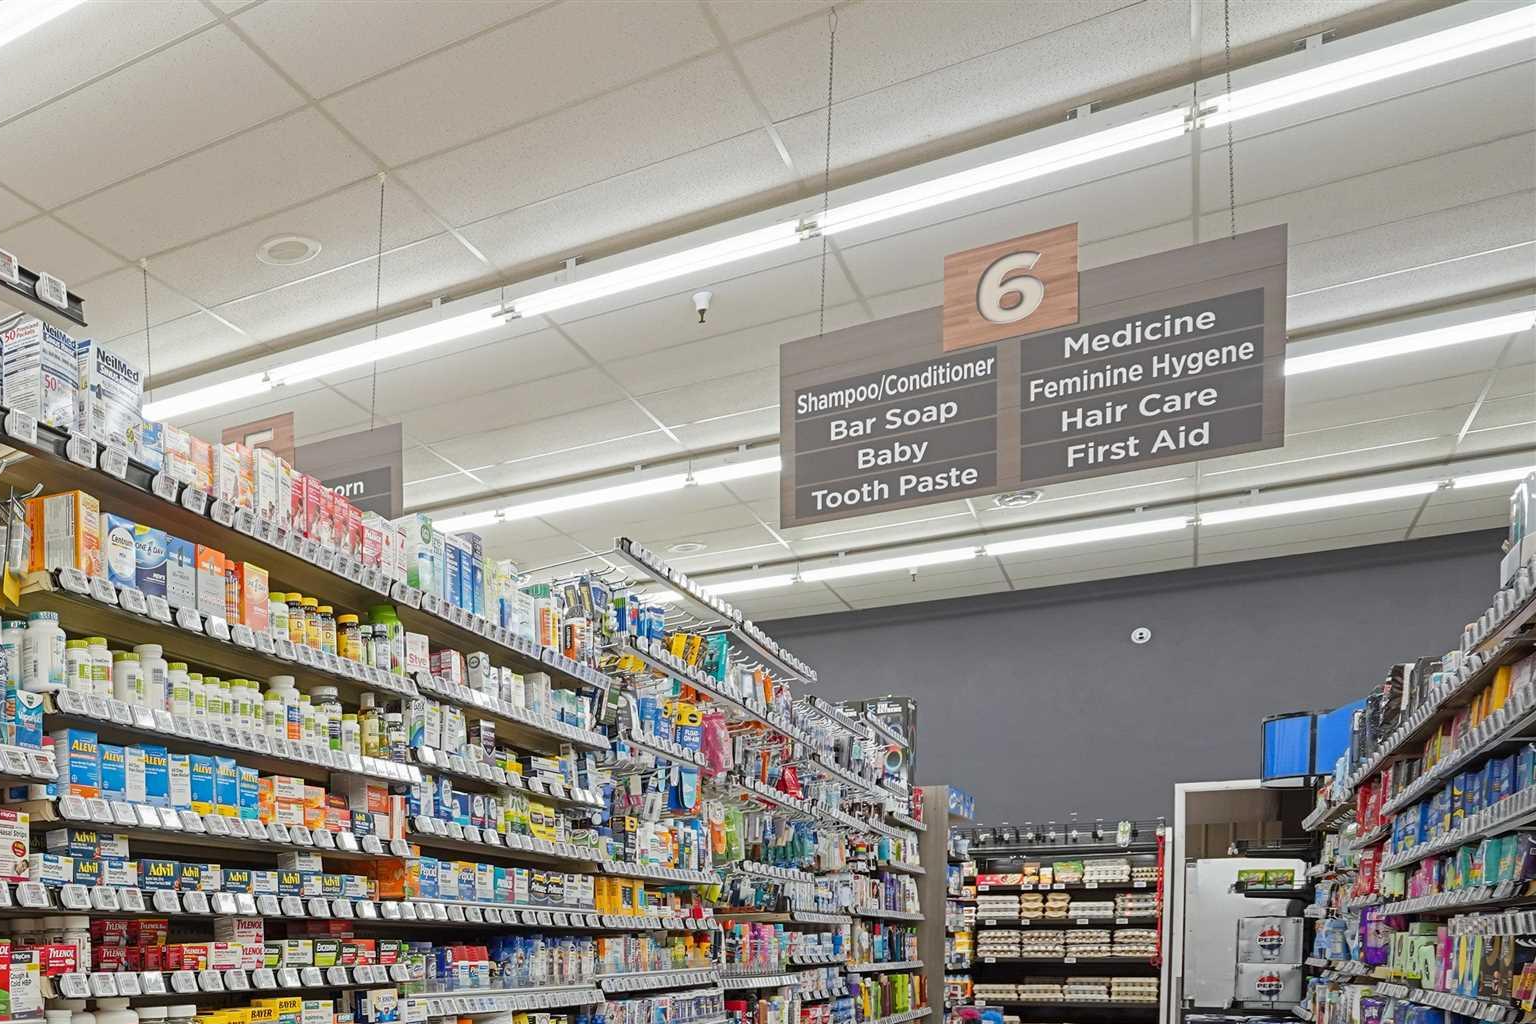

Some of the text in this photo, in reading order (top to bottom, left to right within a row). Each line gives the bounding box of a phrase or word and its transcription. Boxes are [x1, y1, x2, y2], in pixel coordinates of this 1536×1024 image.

[976, 249, 1046, 325] 6
[43, 321, 77, 349] NeilMed
[1063, 310, 1217, 359] Medicine
[97, 347, 139, 383] NeilMed
[797, 355, 995, 415] Shampoo/Conditioner
[1029, 340, 1255, 402] Feminine Hygene
[829, 400, 958, 441] Bar Soap
[1061, 386, 1218, 432] Hair Care
[857, 440, 929, 474] Baby
[1067, 422, 1210, 468] First Aid
[812, 466, 978, 511] Tooth Paste
[73, 832, 96, 843] Advil
[149, 863, 174, 877] Advil
[251, 1009, 272, 1018] BAYER
